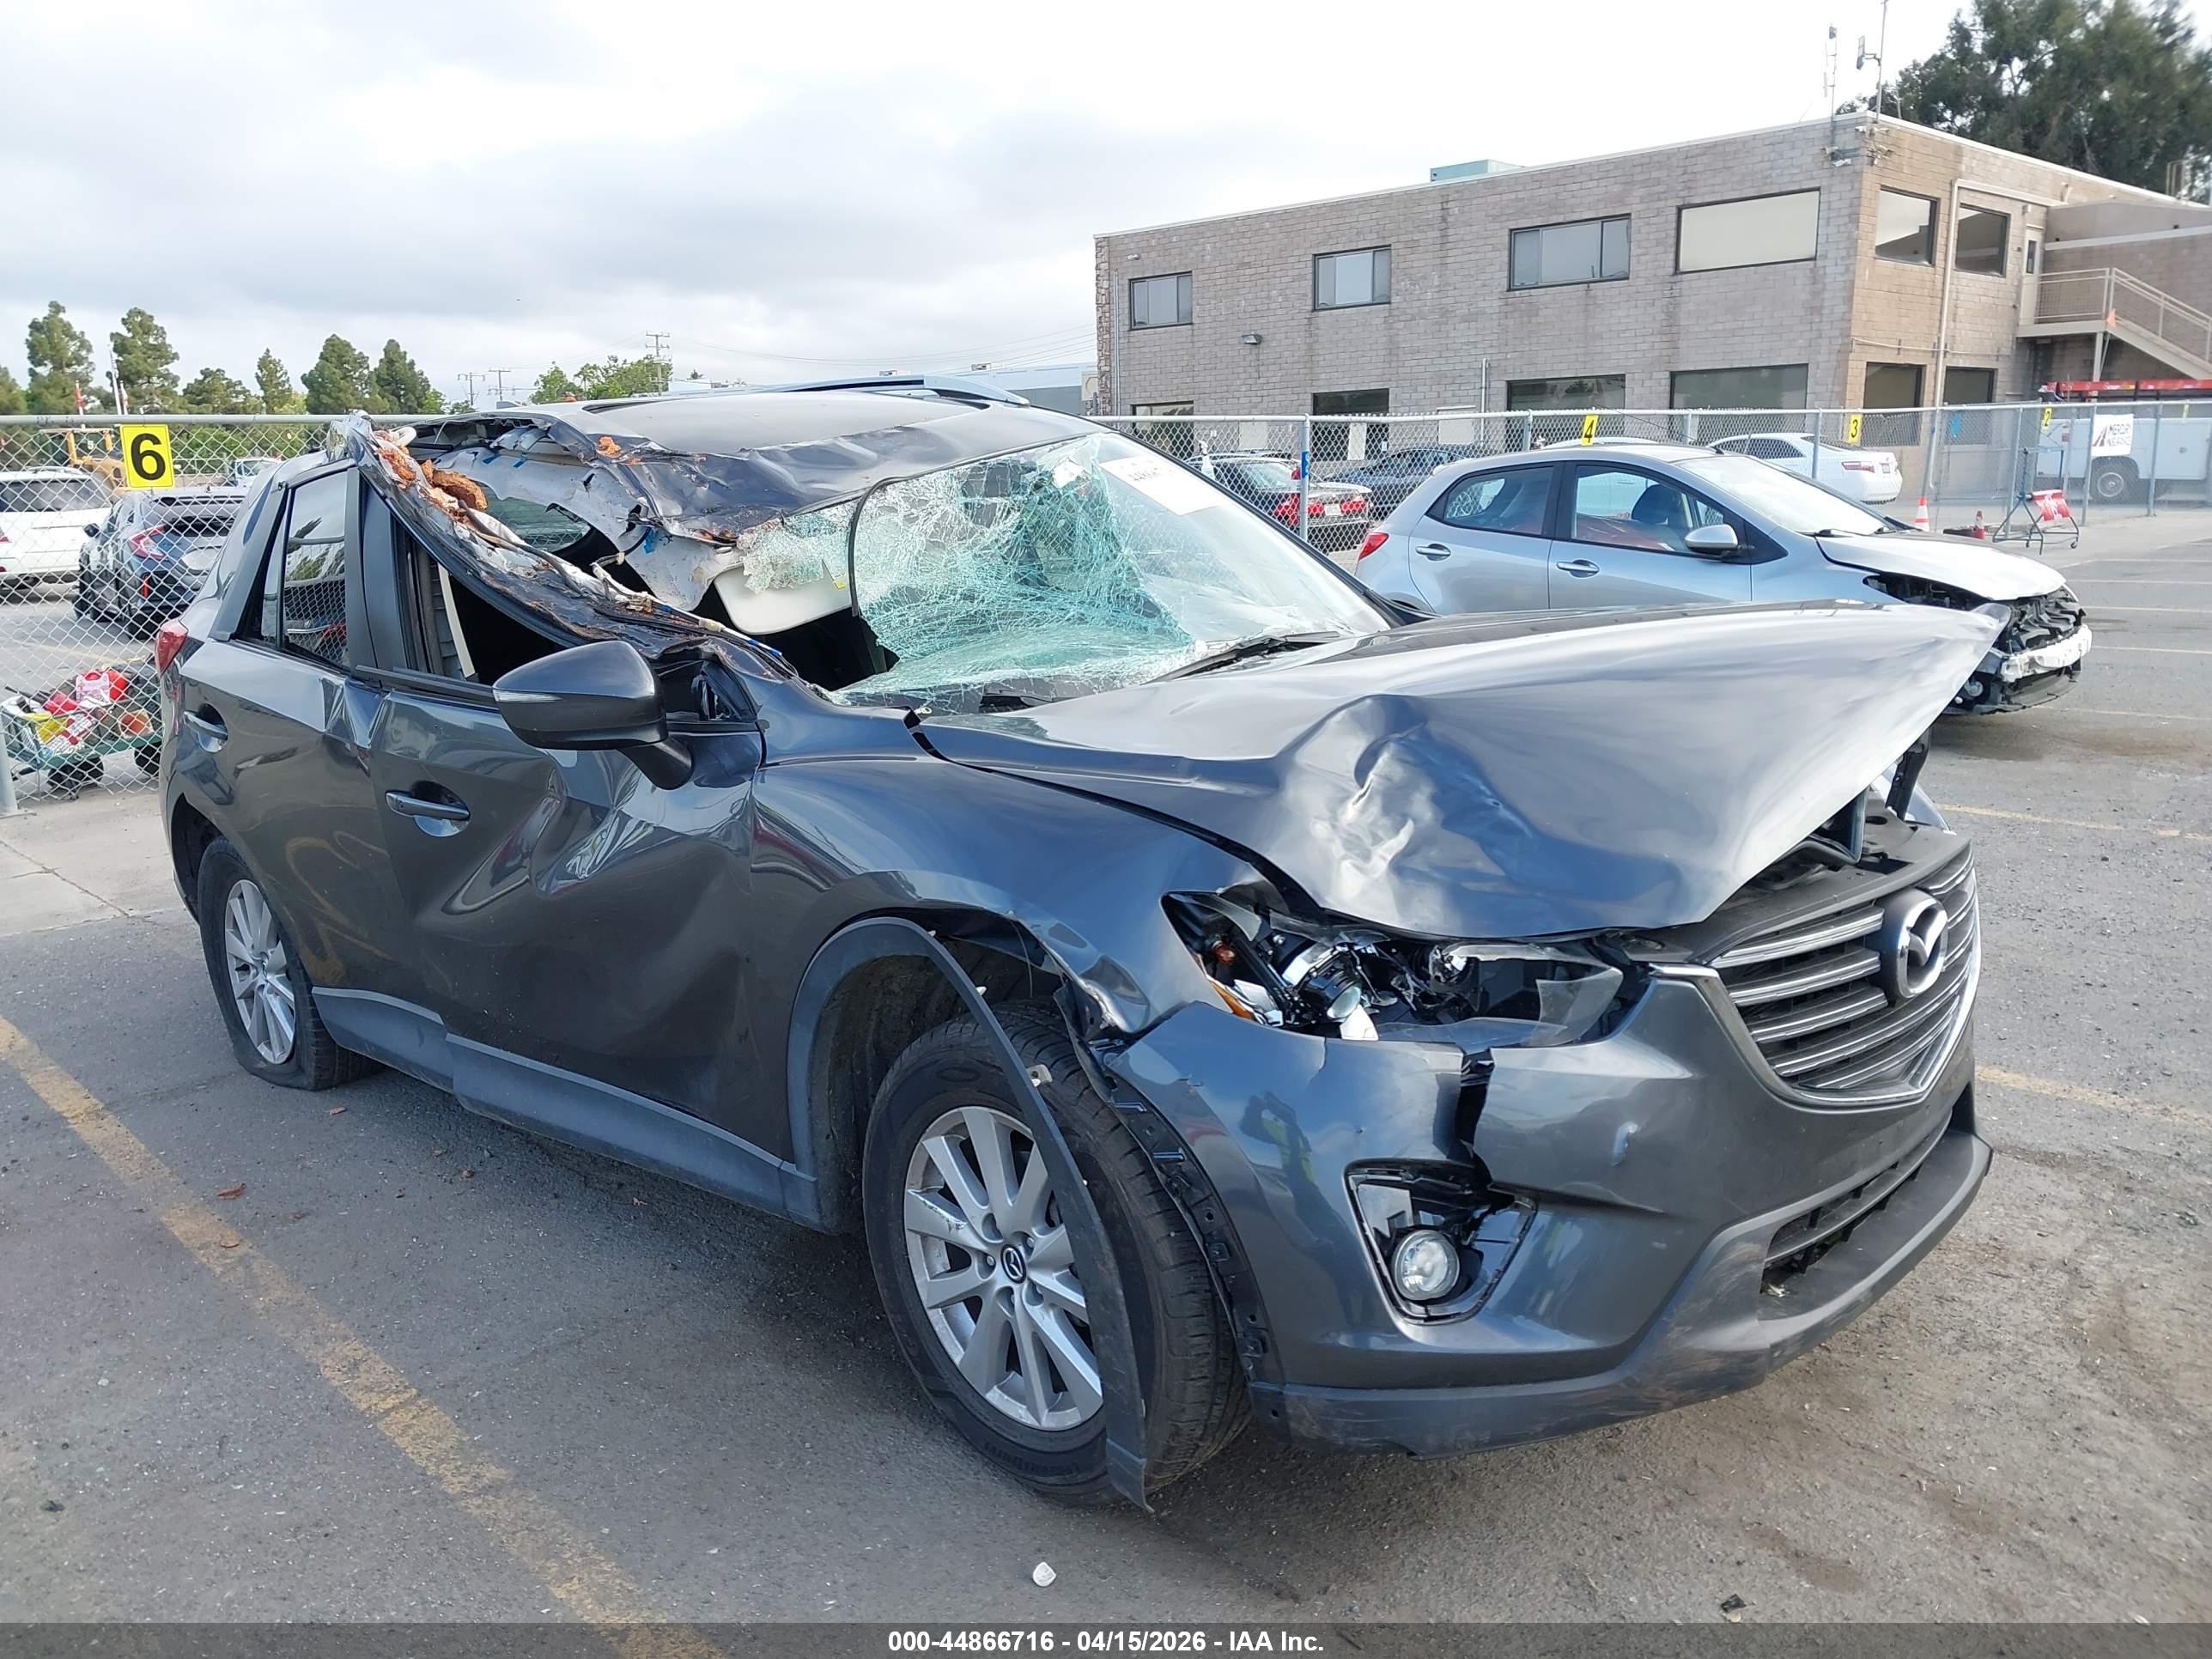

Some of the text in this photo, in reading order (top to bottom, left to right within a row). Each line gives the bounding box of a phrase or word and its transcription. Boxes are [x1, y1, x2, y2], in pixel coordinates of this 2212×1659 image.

[1850, 418, 1858, 439] 3
[2044, 410, 2051, 427] 2
[1583, 419, 1595, 444] 4
[131, 433, 167, 481] 6
